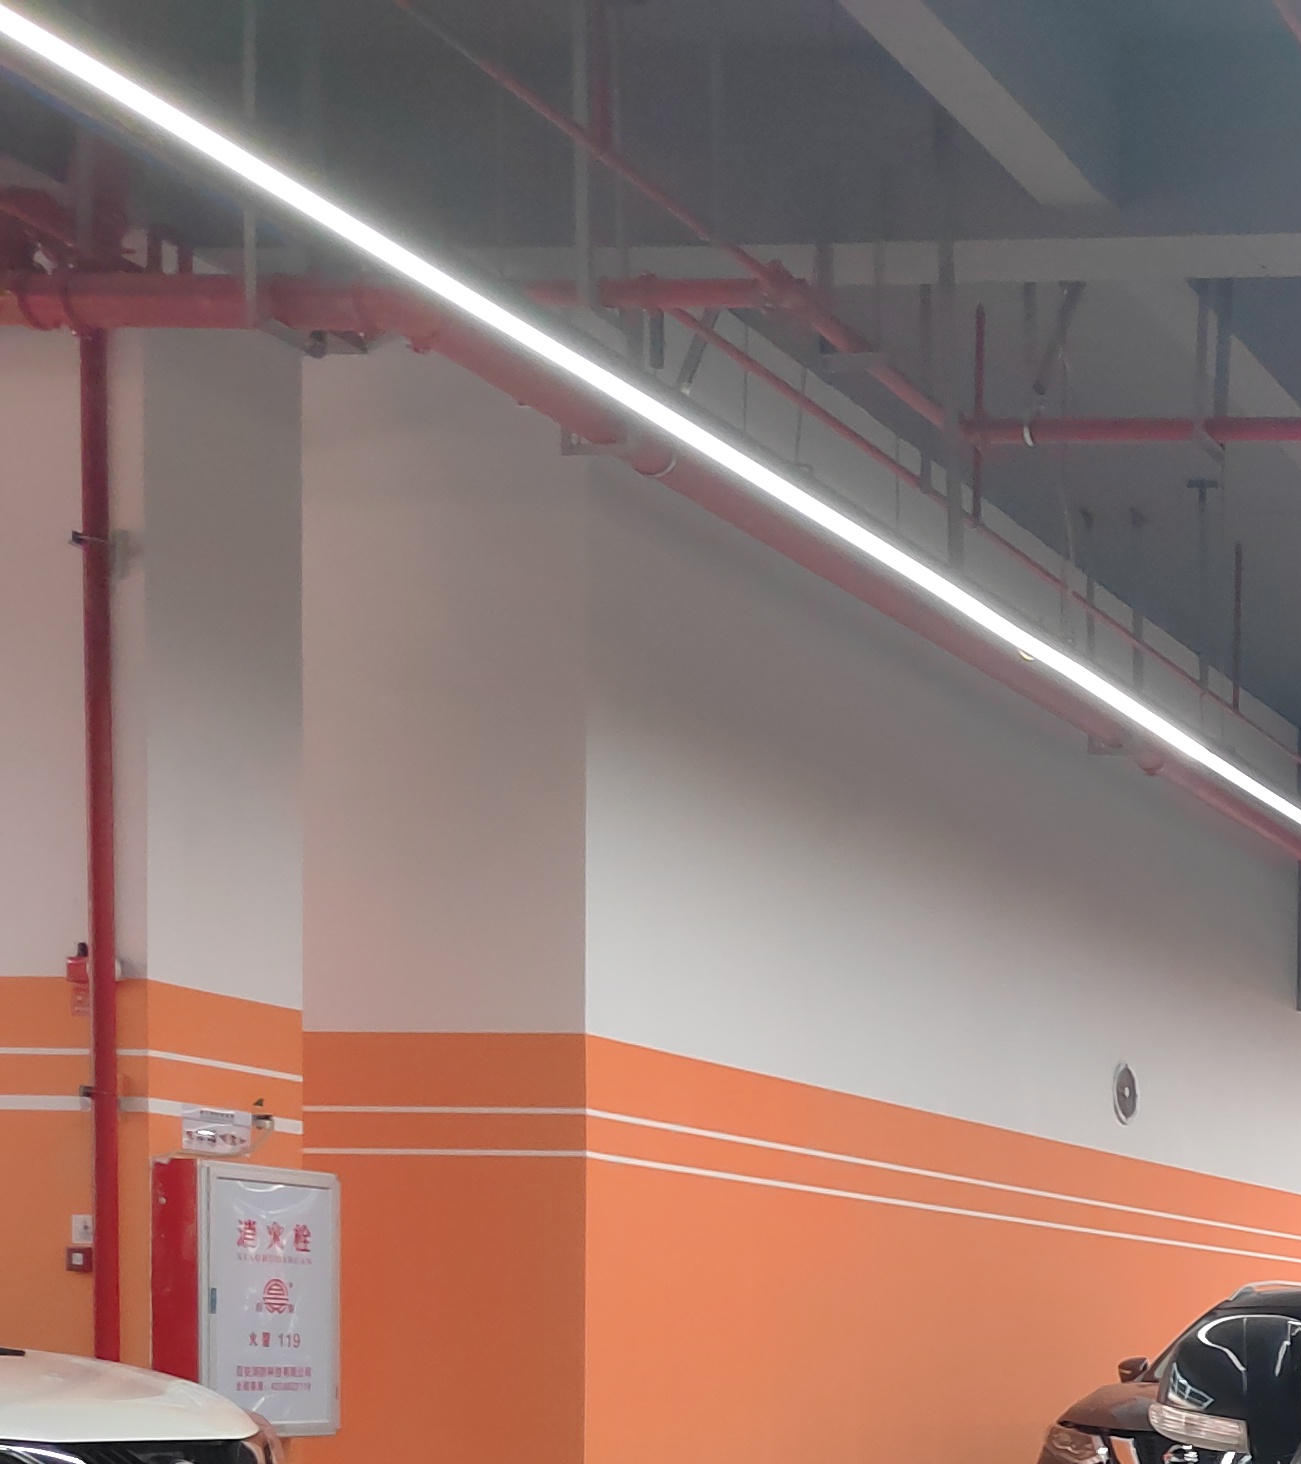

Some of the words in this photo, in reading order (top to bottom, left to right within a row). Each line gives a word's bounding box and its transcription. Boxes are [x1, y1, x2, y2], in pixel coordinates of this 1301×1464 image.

[236, 1219, 311, 1252] 消火栓
[278, 1333, 301, 1348] 119
